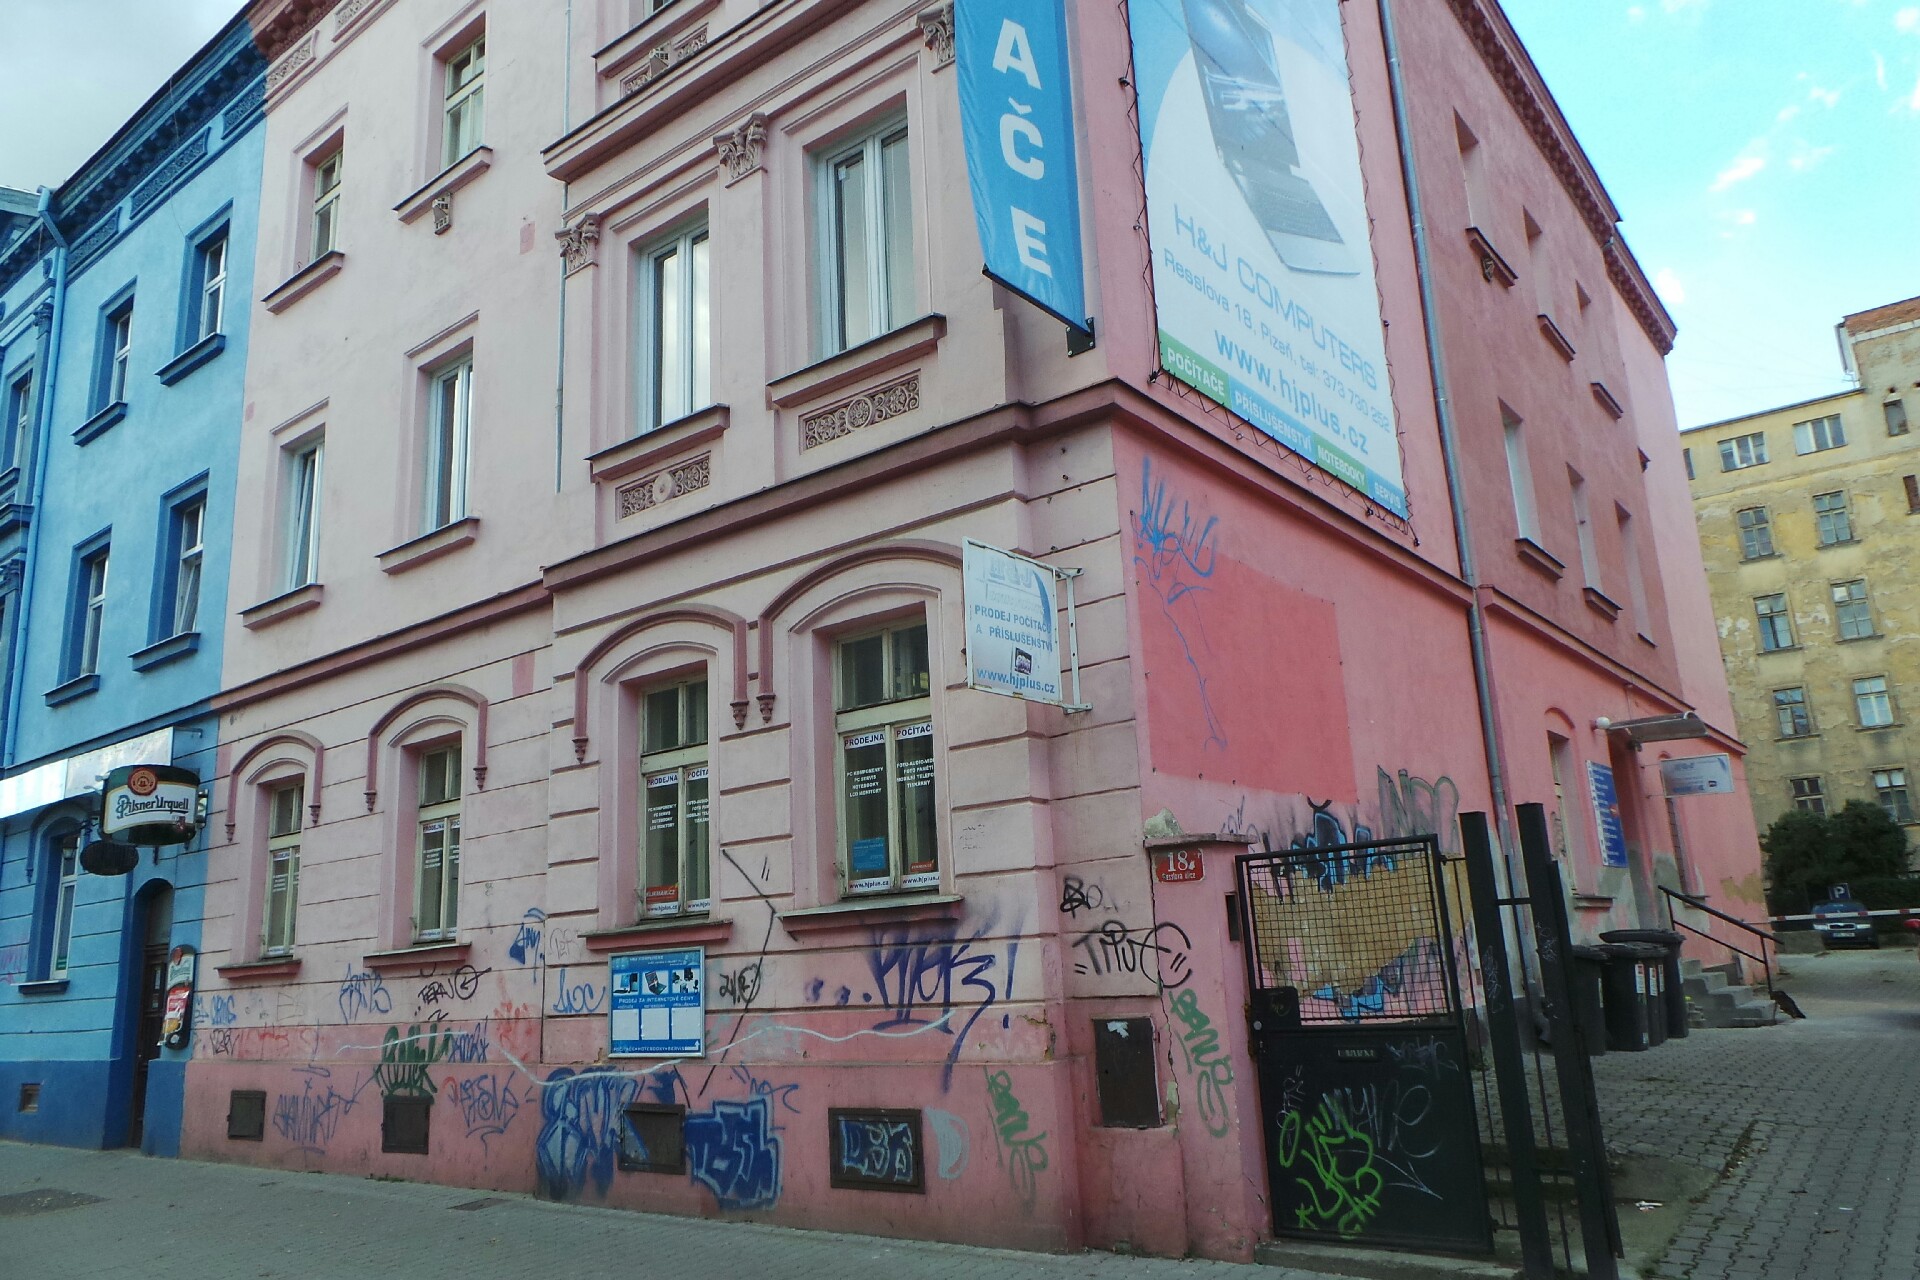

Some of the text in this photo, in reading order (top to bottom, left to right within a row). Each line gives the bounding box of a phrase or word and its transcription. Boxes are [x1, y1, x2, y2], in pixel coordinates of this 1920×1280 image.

[1164, 248, 1229, 313] Resslova
[1174, 202, 1377, 391] H&J COMPUTERS
[1215, 329, 1369, 455] www.hjplus.cz
[1167, 346, 1402, 509] POČÍTAČE PŘÍSLUŠENSTVÍ NOTEBOOKY SERVIS
[974, 604, 1011, 622] PRODEJ
[976, 623, 1053, 653] A PŘÍSLUŠENSTVÍ
[976, 668, 1056, 694] www.hjplus.cz
[844, 733, 885, 747] PRODEJNA
[647, 774, 678, 786] PRODEJNA
[115, 794, 189, 820] Pilsner Urquell
[1833, 886, 1846, 899] P
